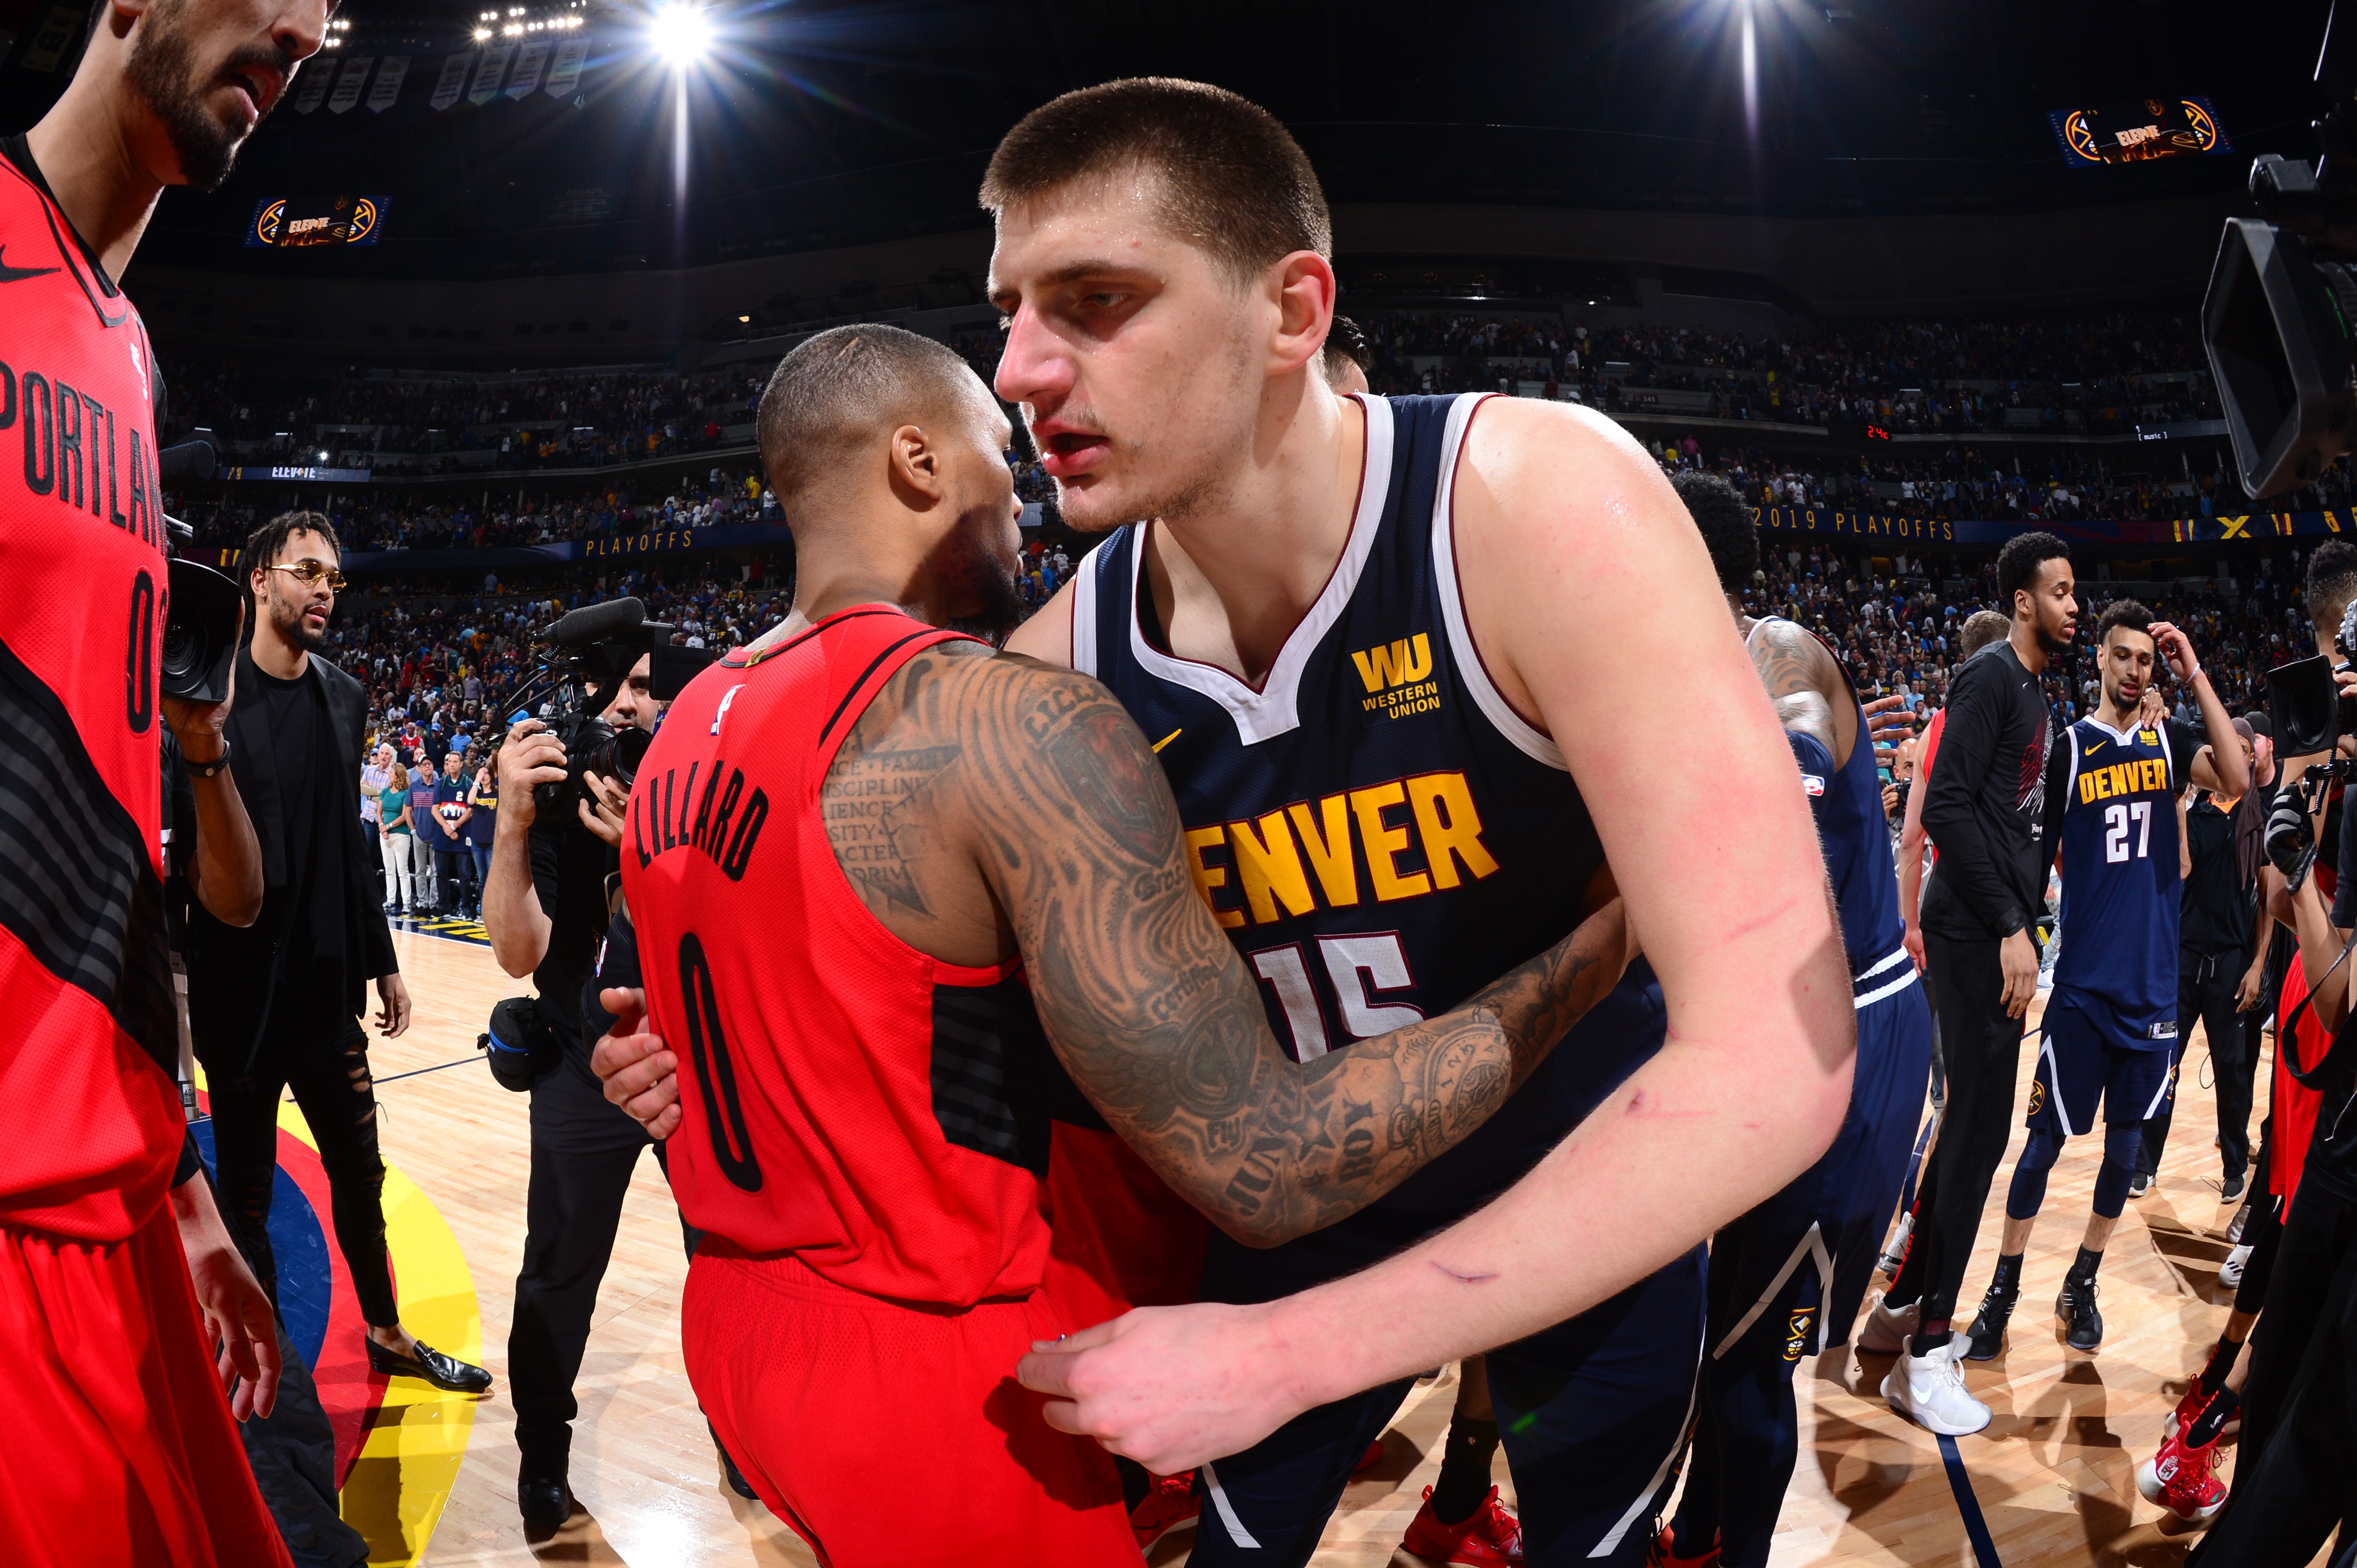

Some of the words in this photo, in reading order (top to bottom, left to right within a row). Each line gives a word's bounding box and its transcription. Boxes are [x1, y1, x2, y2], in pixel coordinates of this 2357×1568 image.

[586, 530, 692, 557] PLAYOFFS
[1753, 507, 1816, 530] 2019
[1836, 513, 1952, 541] PLAYOFFS
[1351, 633, 1433, 693] WU
[1362, 681, 1438, 711] WESTERN
[1389, 696, 1440, 719] UNION
[456, 791, 464, 802] 2
[2078, 759, 2167, 805] DENVER
[634, 760, 769, 883] LILLARD
[2105, 801, 2152, 863] 27
[1247, 929, 1428, 1065] 15
[679, 932, 763, 1192] 0
